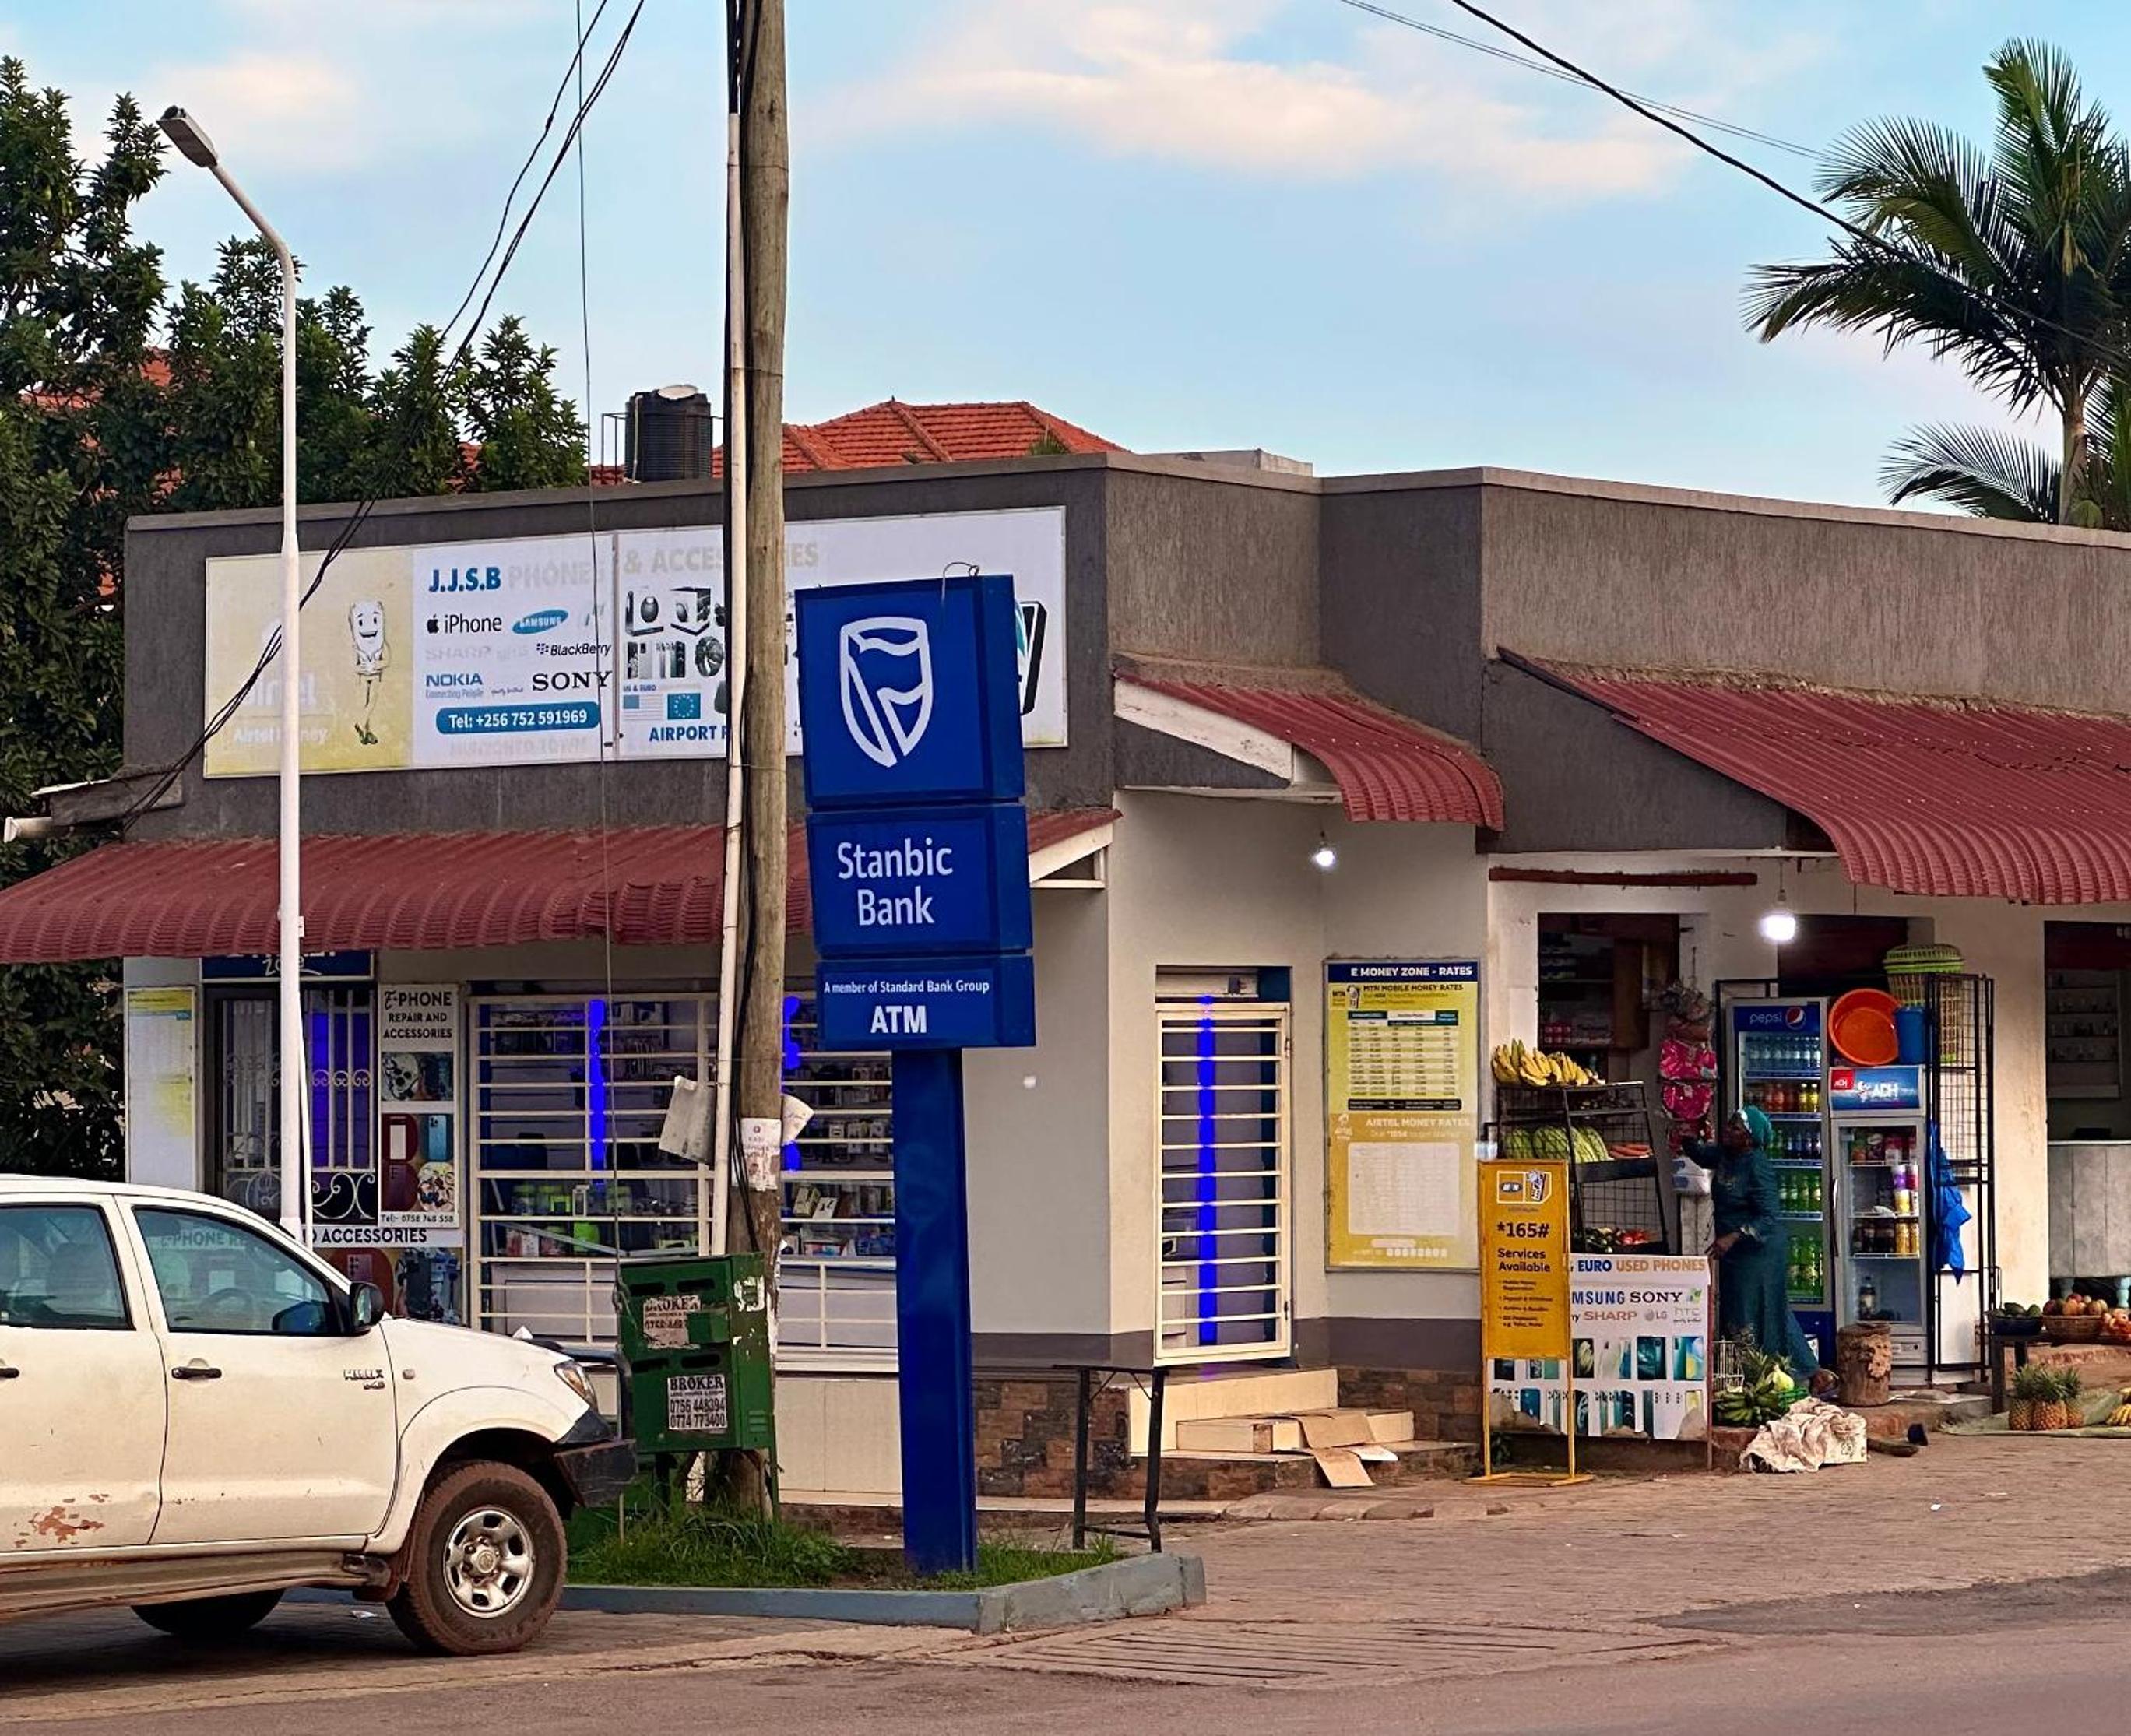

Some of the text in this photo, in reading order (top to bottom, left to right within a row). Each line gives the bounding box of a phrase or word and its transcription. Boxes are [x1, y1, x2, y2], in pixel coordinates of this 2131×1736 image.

[428, 567, 501, 592] J.J.S.B
[445, 613, 502, 634] iPhone
[550, 643, 612, 656] BlackBerry
[426, 670, 613, 691] NOKIA SONY
[448, 709, 588, 728] Tel: +256 752 591969
[649, 726, 717, 742] AIRPORT
[837, 838, 954, 880] Stanbic
[857, 886, 934, 926] Bank
[1351, 968, 1358, 976] E
[1360, 968, 1398, 977] MONEY
[1401, 967, 1429, 976] ZONE
[1438, 966, 1472, 976] RATES
[824, 979, 990, 994] A member of Standard Bank Group
[389, 1013, 447, 1022] REPAIR AND
[870, 1005, 927, 1034] ATM
[1749, 1012, 1782, 1024] pepsi
[383, 1028, 452, 1038] ACCESSORIES
[322, 1228, 427, 1243] ACCESSORIES
[1498, 1247, 1546, 1259] Services
[1499, 1261, 1550, 1272] Available
[1577, 1260, 1612, 1272] EURO
[1616, 1260, 1649, 1272] USED
[1653, 1259, 1705, 1272] PHONES
[1630, 1291, 1683, 1303] SONY
[1583, 1310, 1637, 1320] SHARP
[1656, 1311, 1668, 1320] LG
[670, 1376, 723, 1390] BROKER
